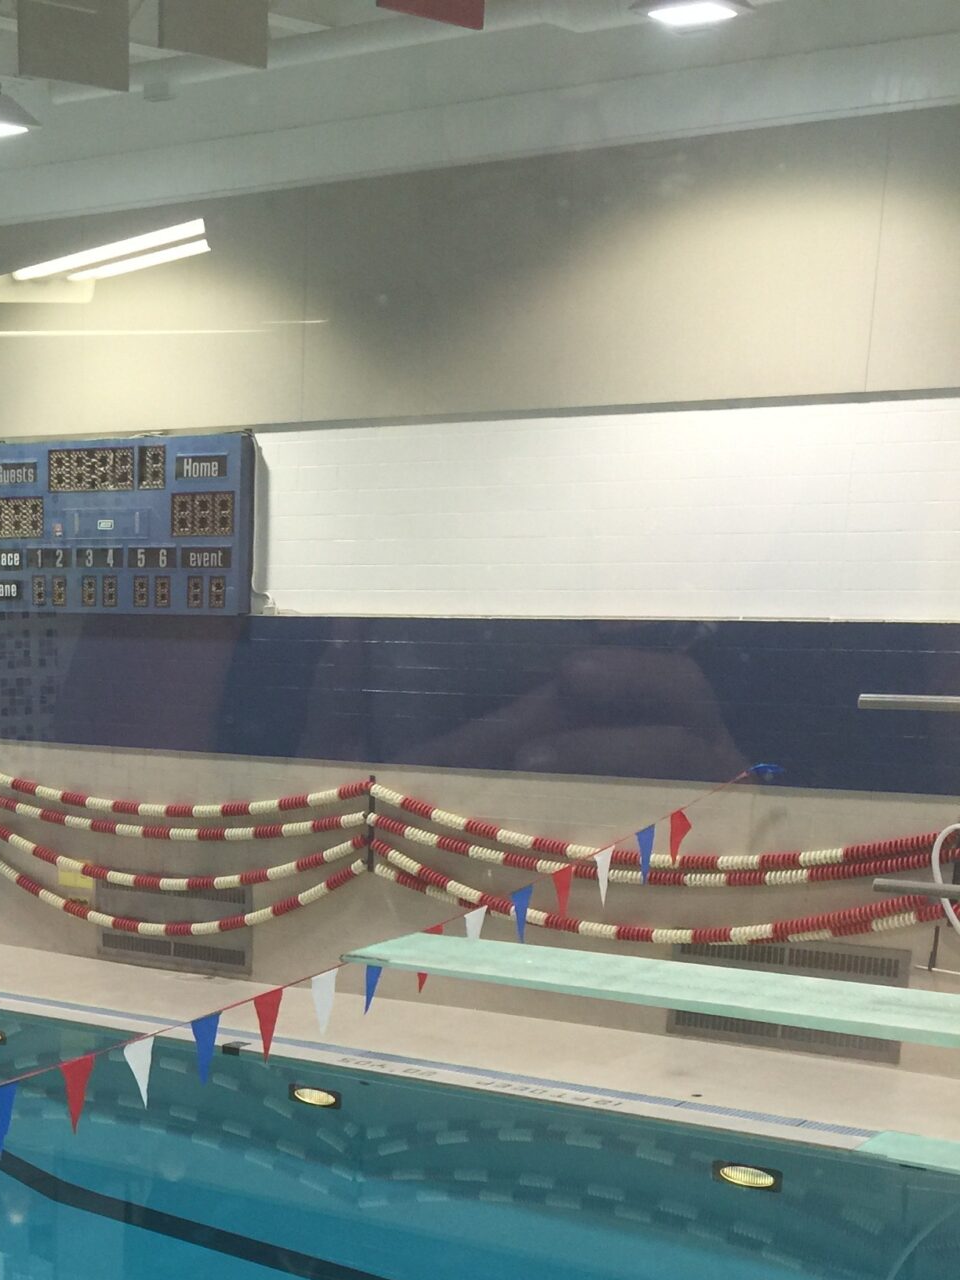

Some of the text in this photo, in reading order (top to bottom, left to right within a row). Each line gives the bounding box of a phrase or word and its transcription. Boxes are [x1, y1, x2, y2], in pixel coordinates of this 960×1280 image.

[183, 458, 219, 477] Home
[36, 550, 41, 567] 1
[55, 550, 63, 567] 2
[85, 550, 93, 567] 3
[106, 550, 114, 567] 4
[137, 550, 145, 567] 5
[159, 550, 167, 567] 6
[190, 551, 223, 567] event
